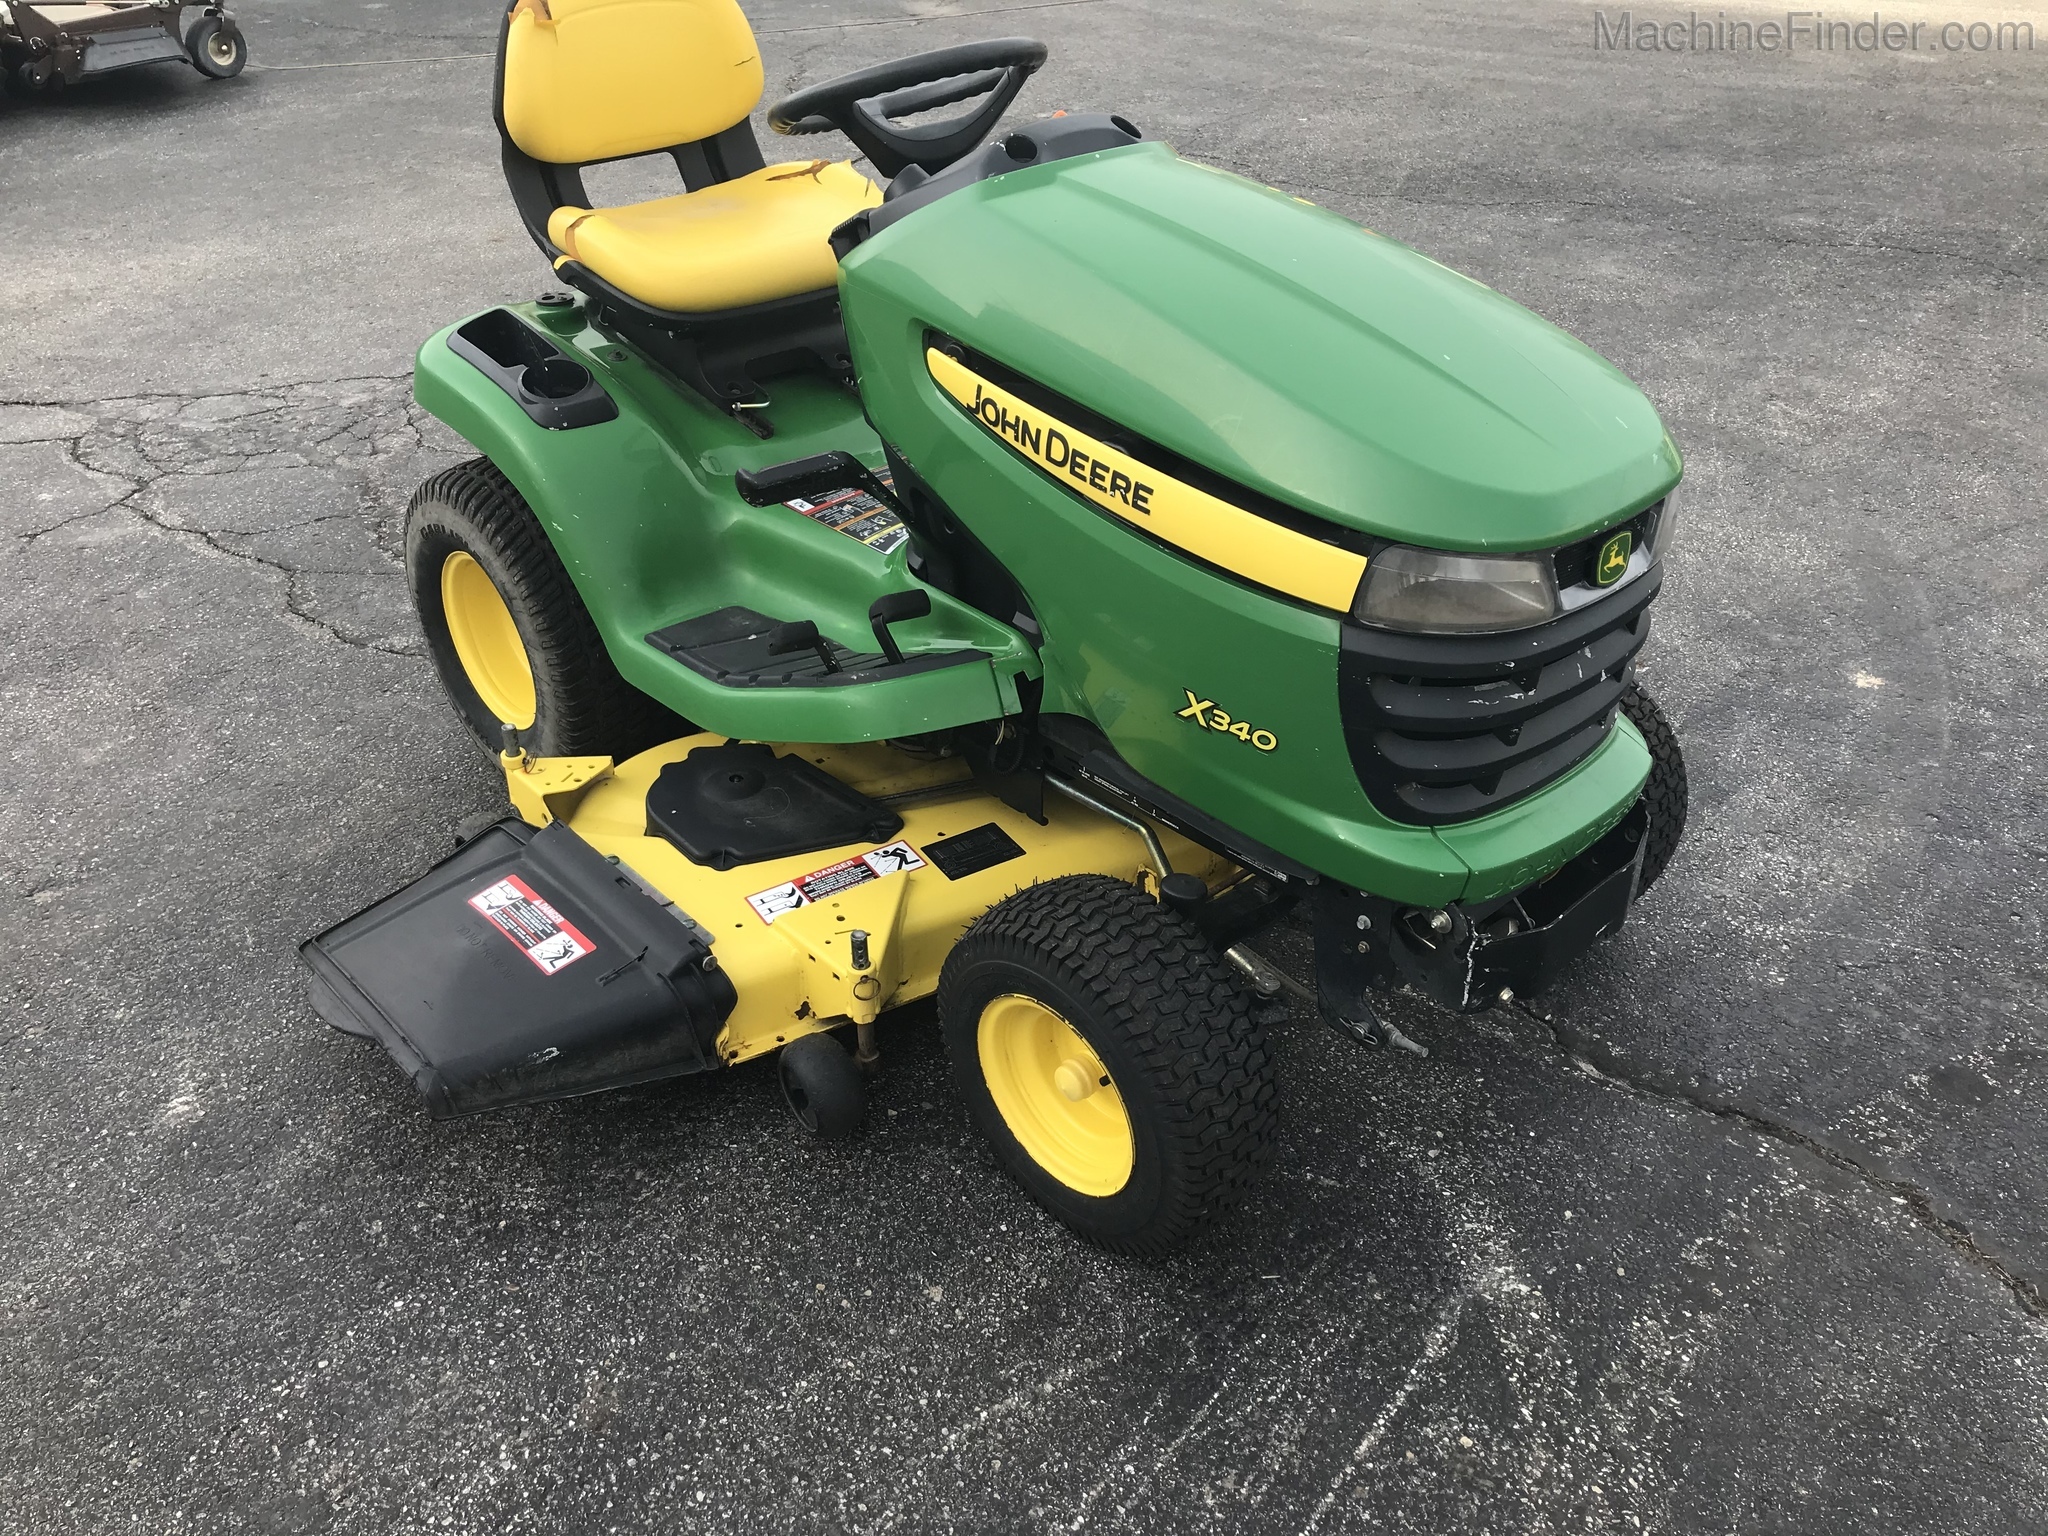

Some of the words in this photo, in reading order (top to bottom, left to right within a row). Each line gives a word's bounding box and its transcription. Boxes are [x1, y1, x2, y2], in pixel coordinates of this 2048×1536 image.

[966, 384, 1042, 456] JOHN
[1045, 427, 1155, 516] DEERE
[1174, 688, 1279, 752] X340
[814, 860, 855, 878] DANGER
[537, 902, 565, 924] DANGER
